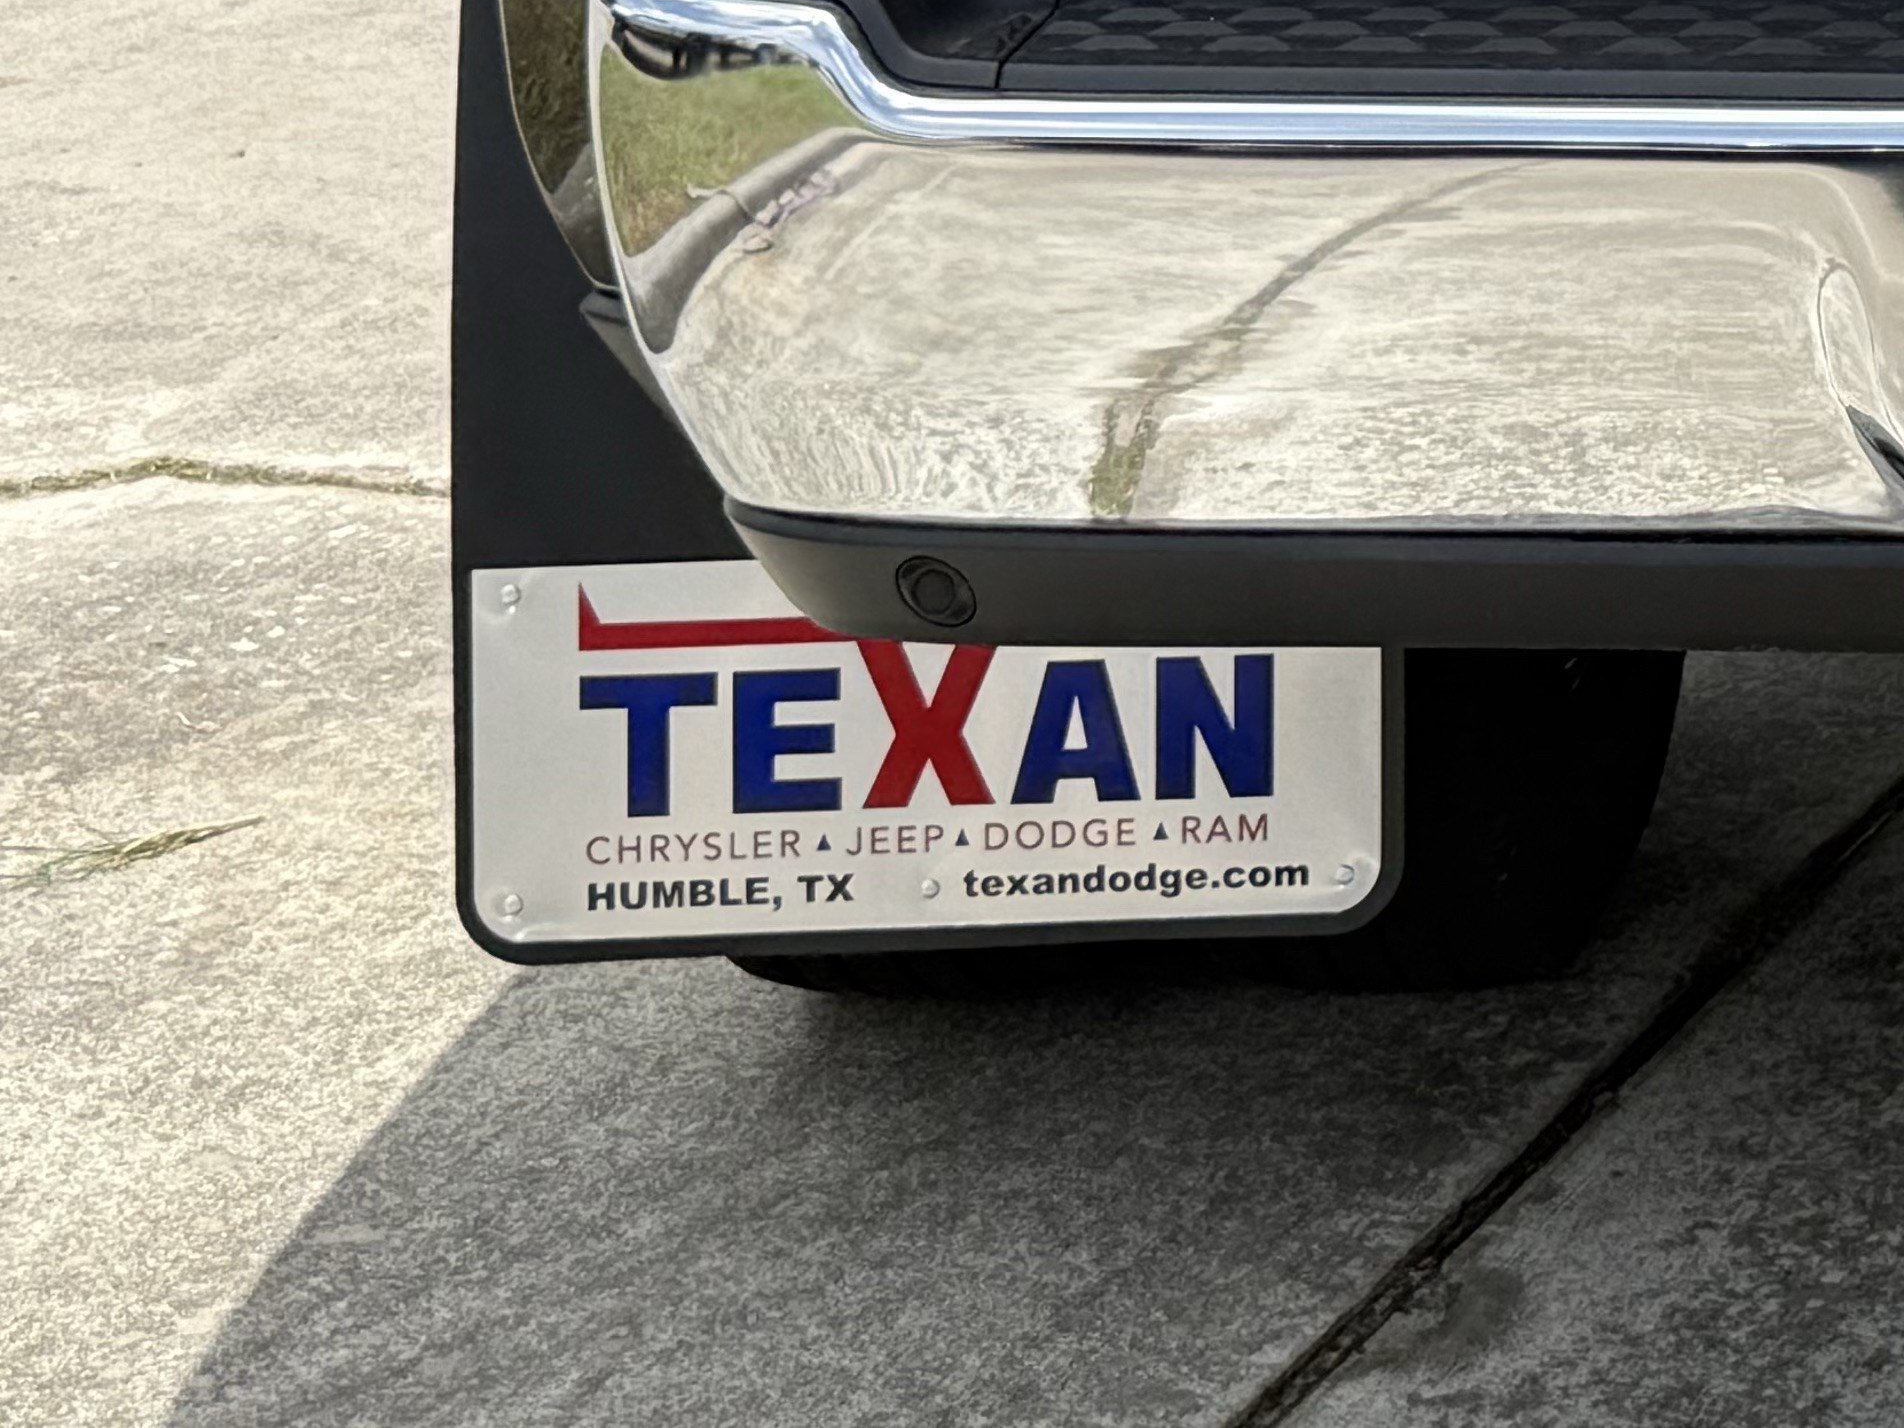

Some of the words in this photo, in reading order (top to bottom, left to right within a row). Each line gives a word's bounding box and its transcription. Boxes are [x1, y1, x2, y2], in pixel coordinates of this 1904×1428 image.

[578, 582, 1275, 818] TEXAN
[585, 829, 801, 866] CHRYSLER
[845, 824, 944, 856] JEEP
[984, 817, 1136, 851] DODGE
[1181, 812, 1268, 844] RAM
[587, 876, 782, 912] HUMBLE,
[796, 873, 855, 904] TX
[962, 862, 1310, 899] texandodge.com
